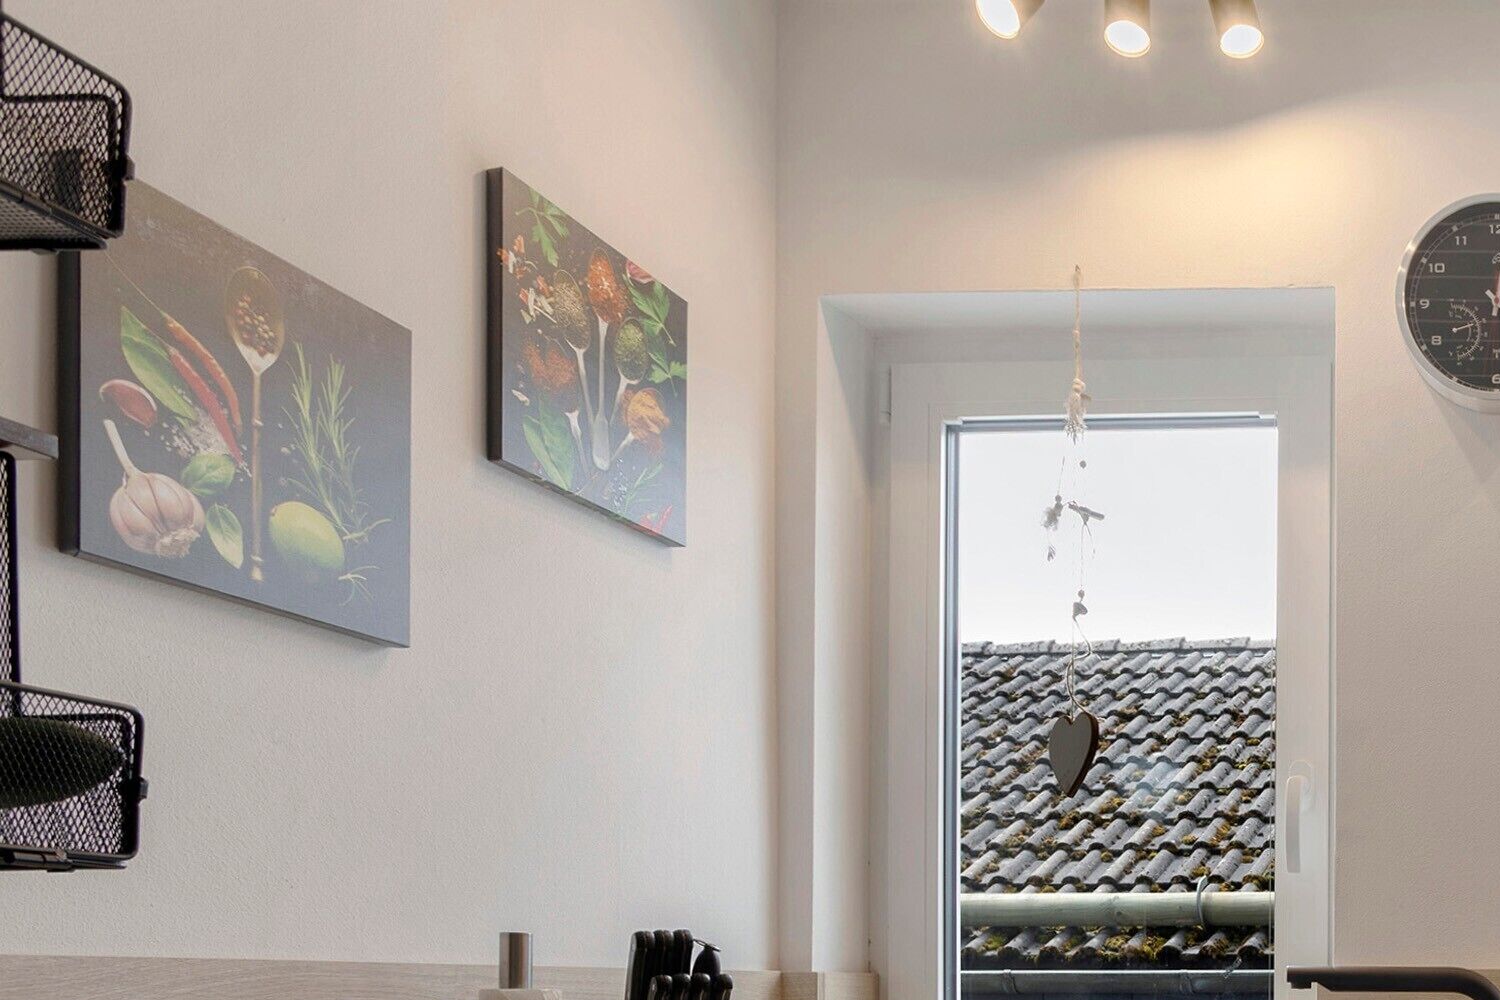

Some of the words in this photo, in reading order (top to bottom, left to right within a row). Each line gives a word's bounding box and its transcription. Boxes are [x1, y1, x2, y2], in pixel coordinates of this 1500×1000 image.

[1455, 236, 1467, 245] 11
[1428, 263, 1445, 273] 10
[1419, 299, 1430, 309] 9
[1431, 335, 1442, 345] 8
